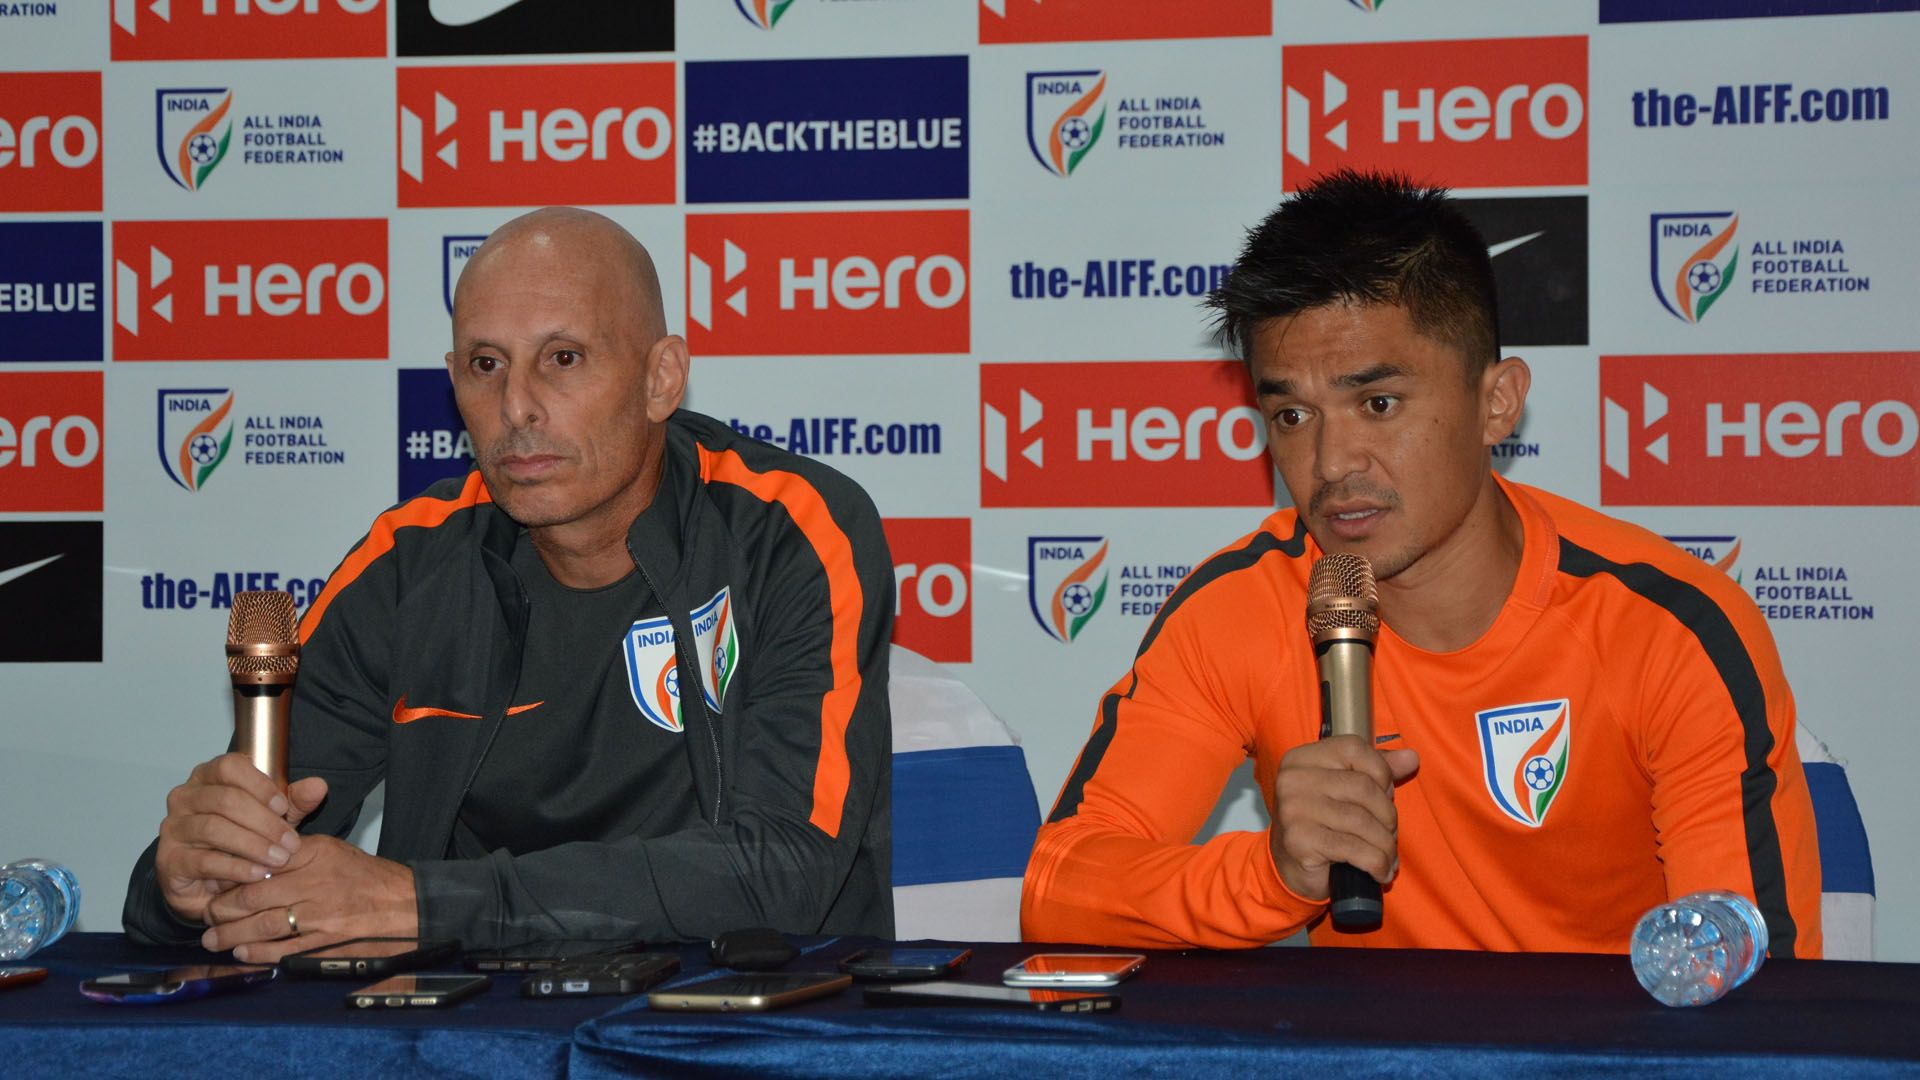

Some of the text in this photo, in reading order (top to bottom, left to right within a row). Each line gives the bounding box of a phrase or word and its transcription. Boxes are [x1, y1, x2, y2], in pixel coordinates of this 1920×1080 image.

[1038, 81, 1082, 95] INDIA
[167, 98, 210, 111] INDIA
[1118, 97, 1201, 112] ALL INDIA
[1631, 83, 1889, 127] the-AIFF.com
[1383, 83, 1584, 143] Hero
[244, 115, 321, 129] ALL INDIA
[1119, 116, 1206, 130] FOOTBALL
[244, 133, 326, 146] FOOTBALL
[489, 106, 672, 162] Hero
[693, 118, 962, 153] #BACKTHEBLUE
[1119, 132, 1224, 148] FEDERATION
[244, 150, 343, 164] FEDERATION
[1663, 223, 1713, 237] INDIA
[1751, 240, 1844, 255] ALL INDIA
[1752, 259, 1849, 274] FOOTBALL
[204, 262, 385, 316] Hero
[779, 254, 966, 310] Hero
[1752, 277, 1870, 293] FEDERATION
[169, 399, 211, 412] INDIA
[245, 416, 323, 429] ALL INDIA
[1706, 400, 1920, 458] Hero
[245, 433, 327, 447] FOOTBALL
[1077, 406, 1267, 462] Hero
[245, 451, 344, 465] FEDERATION
[1040, 547, 1084, 560] INDIA
[1120, 565, 1192, 579] ALL INDI
[1754, 567, 1847, 581] ALL INDIA
[1755, 586, 1853, 601] FOOTBALL
[695, 611, 719, 637] INDIA
[1494, 716, 1544, 736] INDIA
